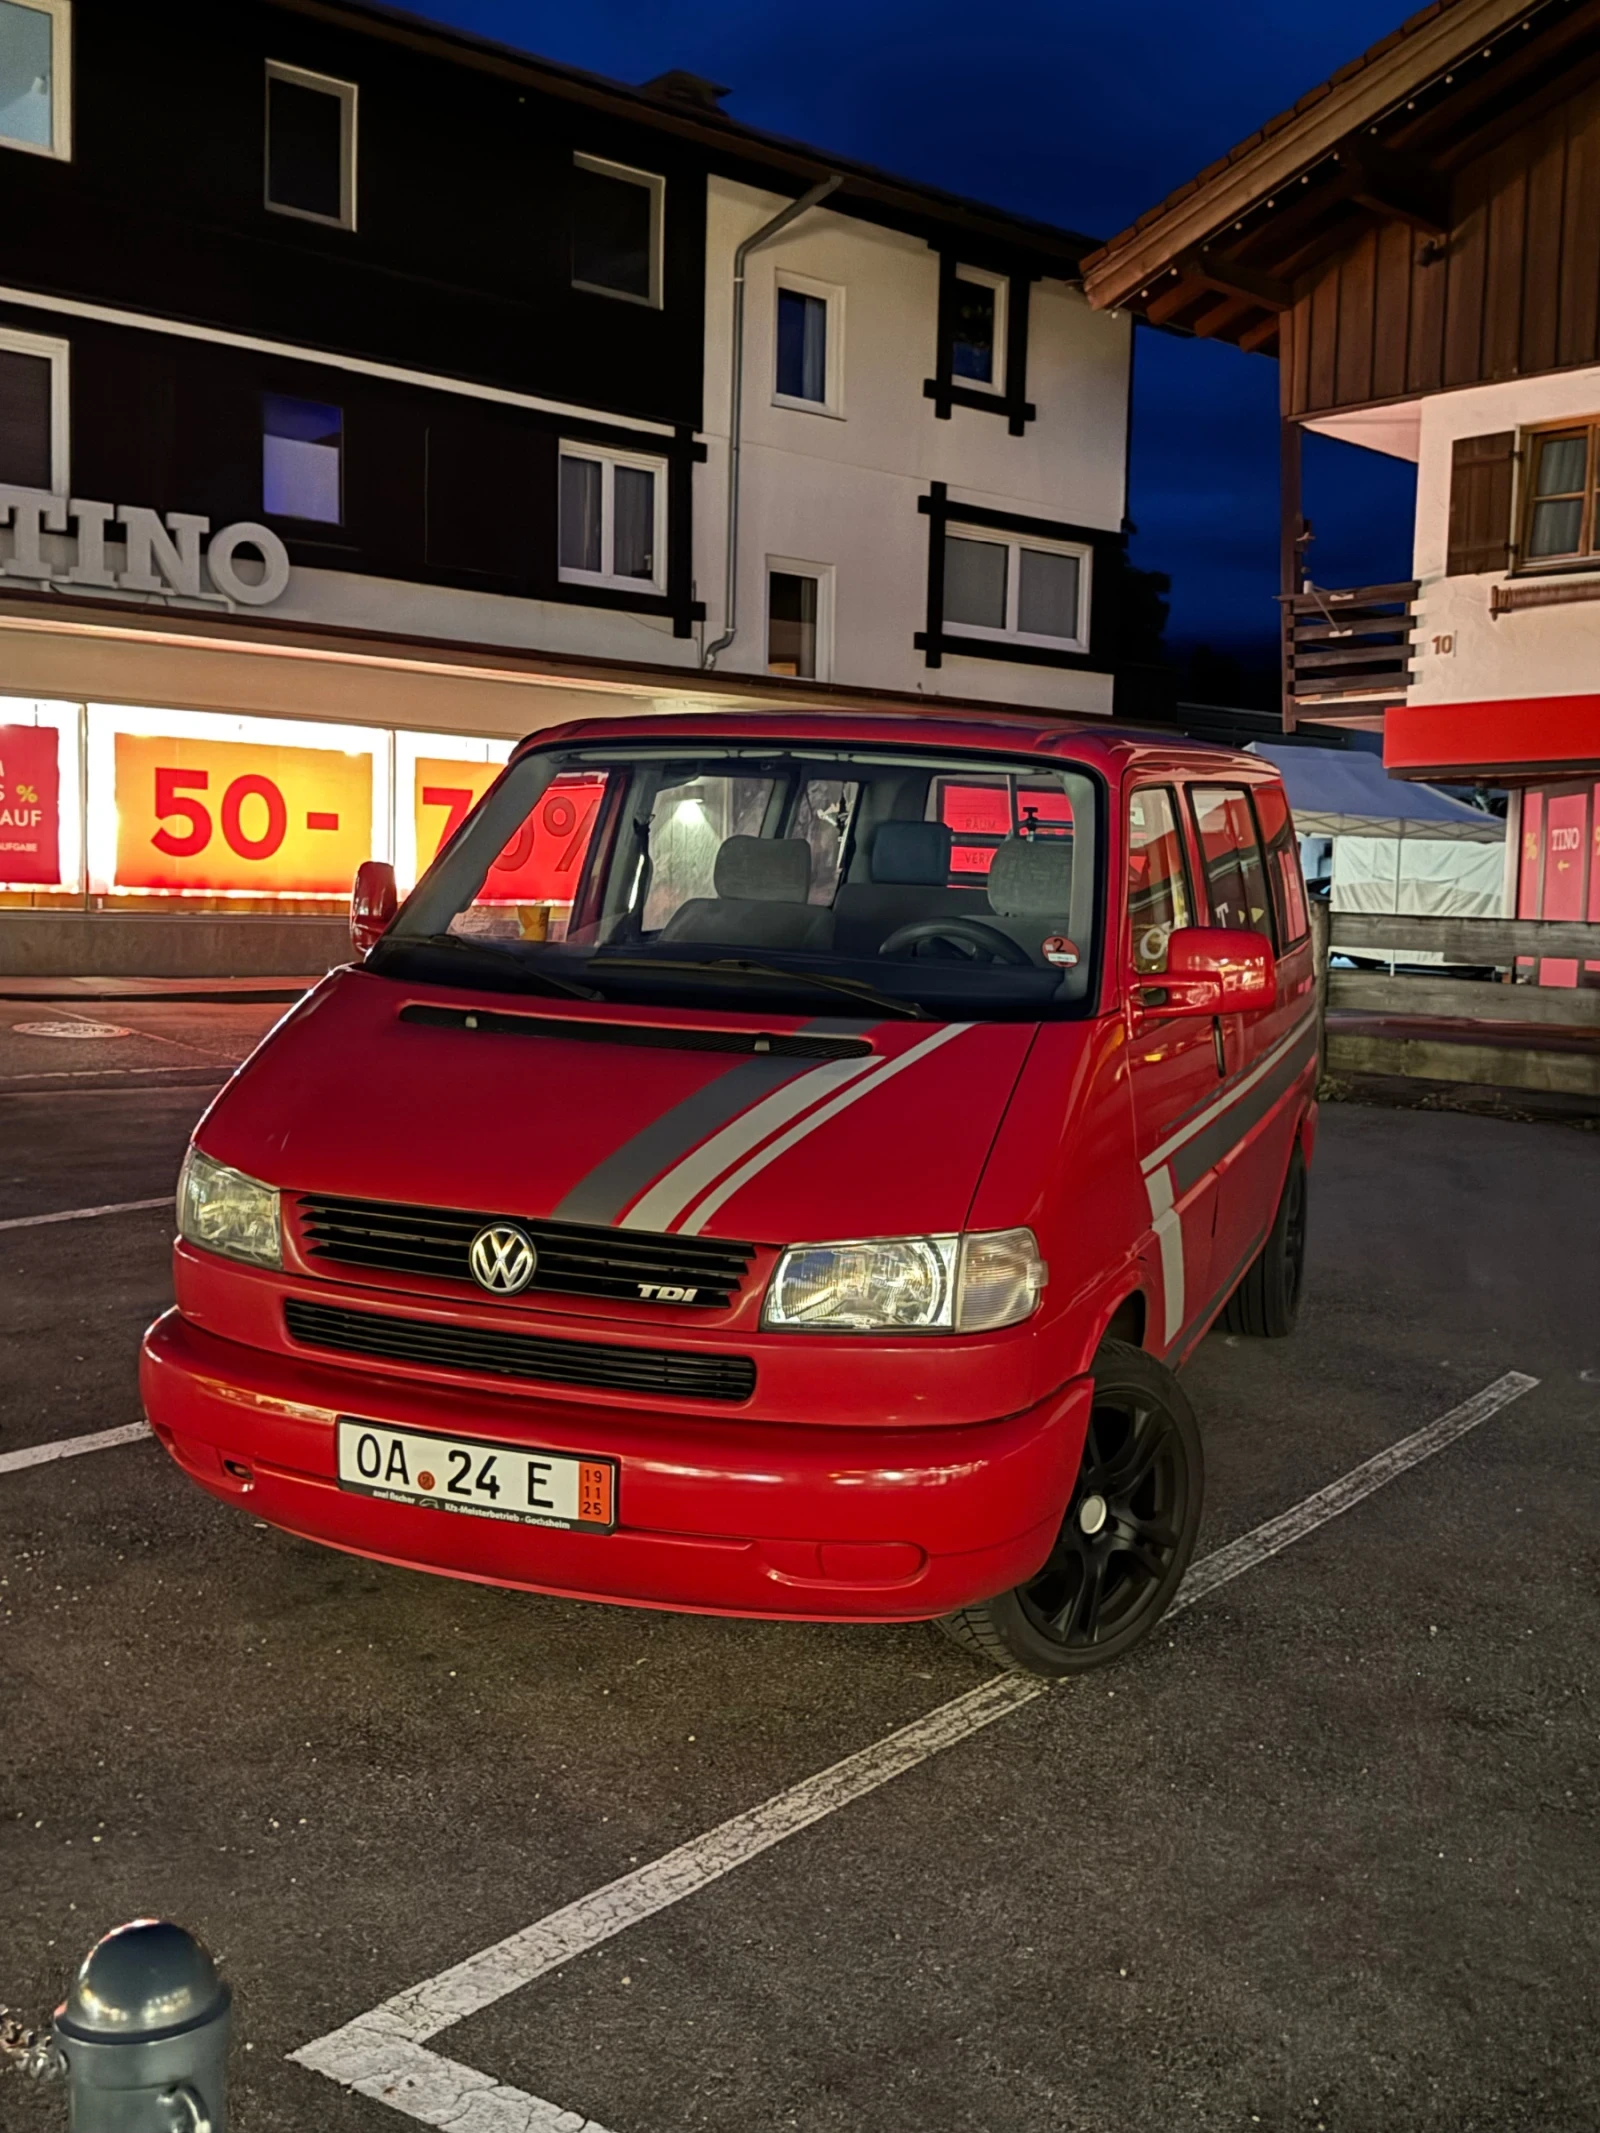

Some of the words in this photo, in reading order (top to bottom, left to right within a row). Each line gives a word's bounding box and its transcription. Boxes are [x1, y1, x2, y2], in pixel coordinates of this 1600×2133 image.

[1431, 634, 1453, 655] 10
[1551, 827, 1580, 851] TINO
[1053, 938, 1066, 953] 2
[471, 1226, 535, 1293] VW
[637, 1283, 698, 1302] TDI
[356, 1433, 410, 1486] OA
[447, 1449, 501, 1500] 24
[527, 1461, 554, 1509] E
[585, 1469, 603, 1484] 19
[584, 1485, 601, 1500] 11
[582, 1501, 602, 1516] 25
